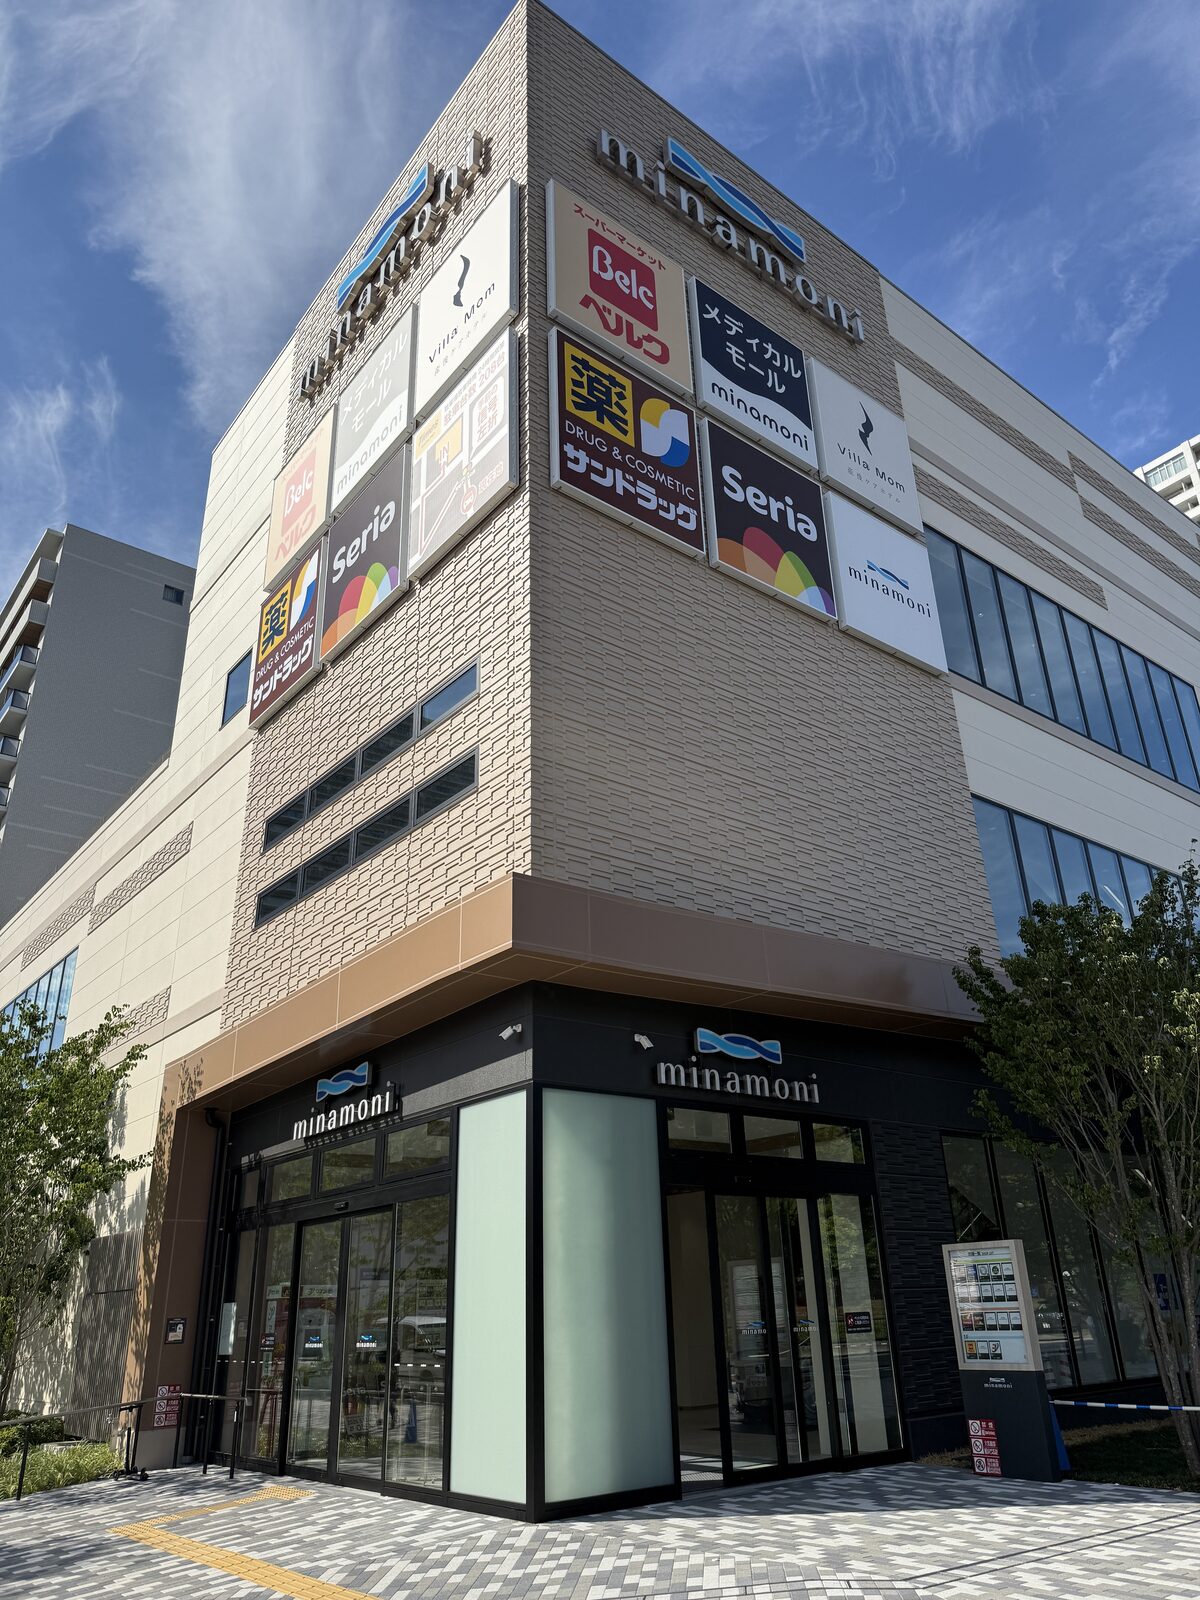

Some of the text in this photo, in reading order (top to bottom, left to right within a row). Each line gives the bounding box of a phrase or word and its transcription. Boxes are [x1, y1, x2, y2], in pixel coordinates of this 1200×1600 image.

[299, 131, 482, 402] minamoni
[573, 203, 667, 271] スーパーマーケット
[599, 128, 866, 344] minamoni
[592, 245, 655, 310] Belc
[429, 283, 495, 363] Villa Mom
[579, 294, 671, 365] ベルク
[702, 303, 802, 379] メディカル
[341, 332, 408, 425] メディカル
[570, 353, 630, 437] 薬
[725, 342, 786, 394] モール
[352, 378, 392, 432] モール
[711, 381, 809, 452] minamoni
[337, 404, 404, 494] minamoni
[565, 420, 695, 501] DRUG & COSMETIC
[837, 443, 905, 493] Villa Mom
[284, 469, 314, 517] Belc
[563, 443, 699, 532] サンドラッグ
[721, 465, 818, 543] Seria
[275, 504, 317, 561] ベルク
[332, 500, 396, 584] Seria
[261, 588, 289, 656] 薬
[848, 564, 932, 620] minamoni
[252, 634, 314, 711] サンドラッグ
[256, 616, 314, 682] DRUG & COSMETIC
[292, 1081, 392, 1141] minamoni
[657, 1055, 820, 1104] minamoni
